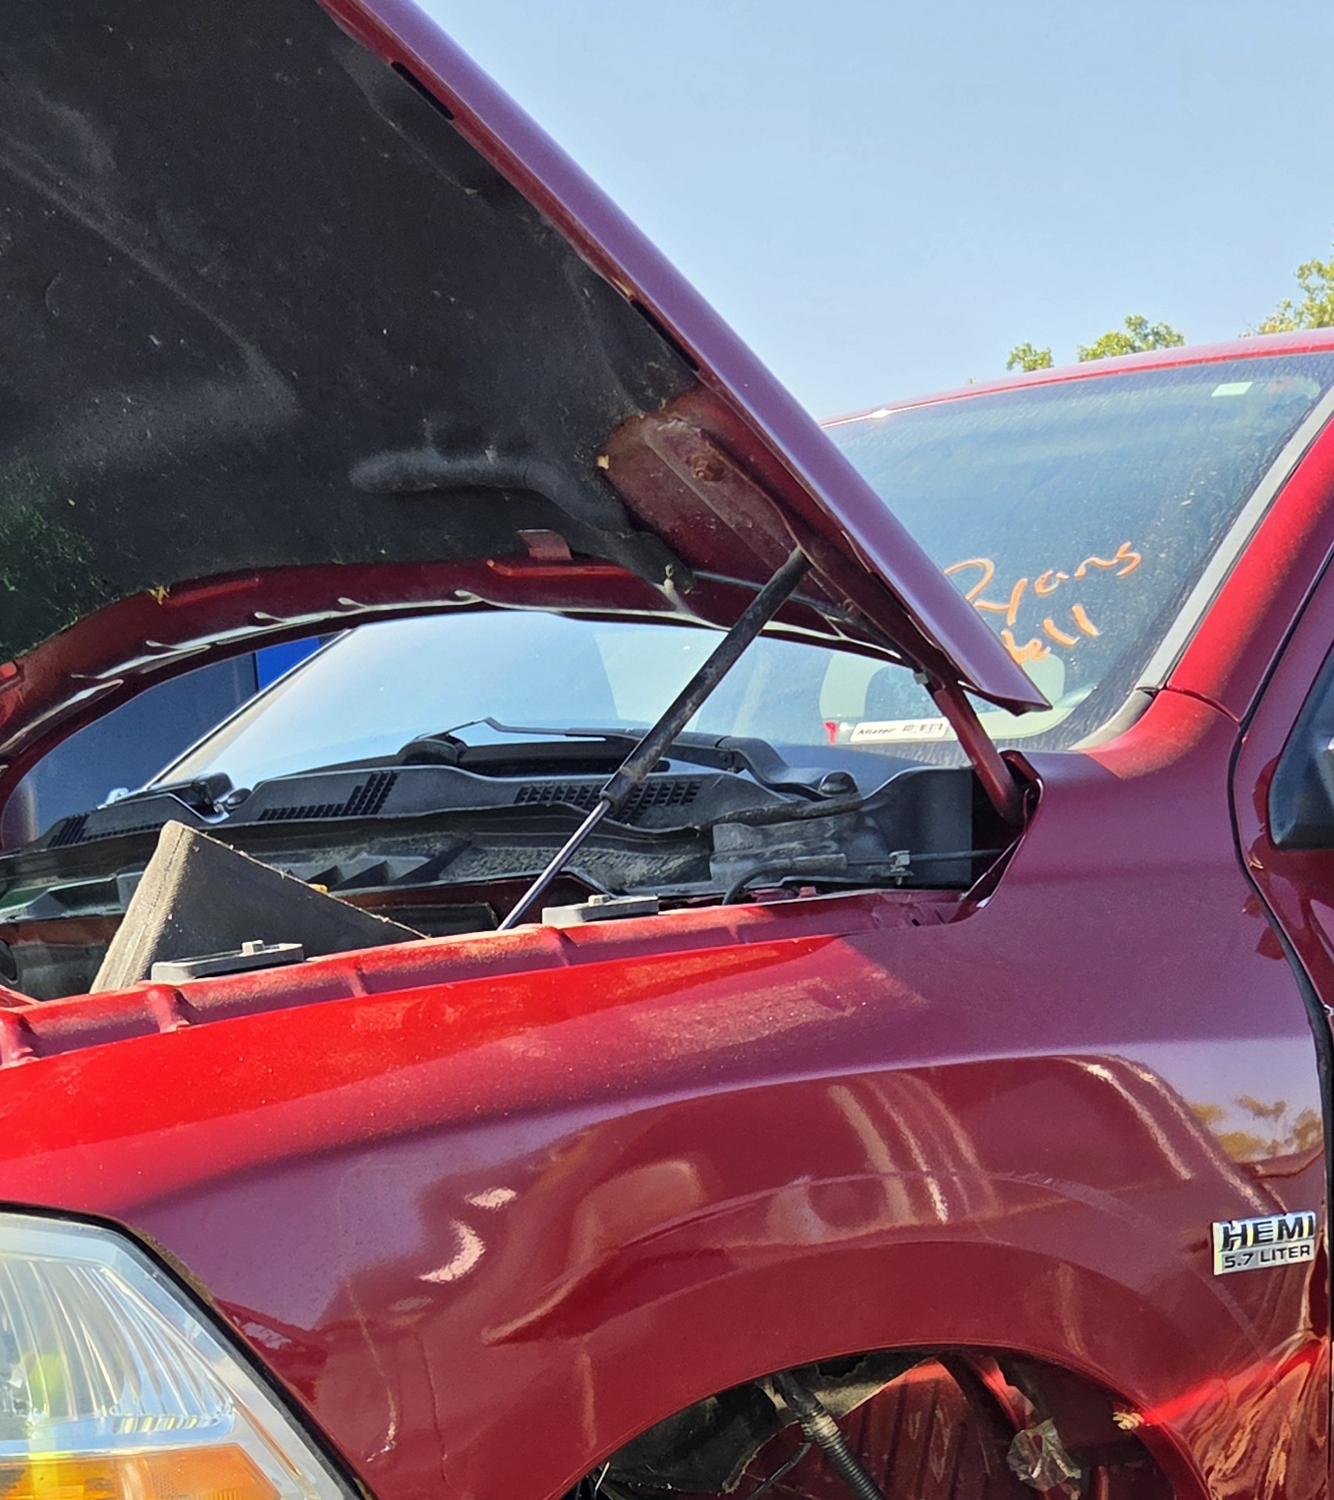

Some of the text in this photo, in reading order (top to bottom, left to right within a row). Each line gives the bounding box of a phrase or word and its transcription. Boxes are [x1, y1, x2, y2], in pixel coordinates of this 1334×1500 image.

[1222, 1215, 1316, 1251] HEMI
[1224, 1244, 1312, 1269] 5.7 LITER
